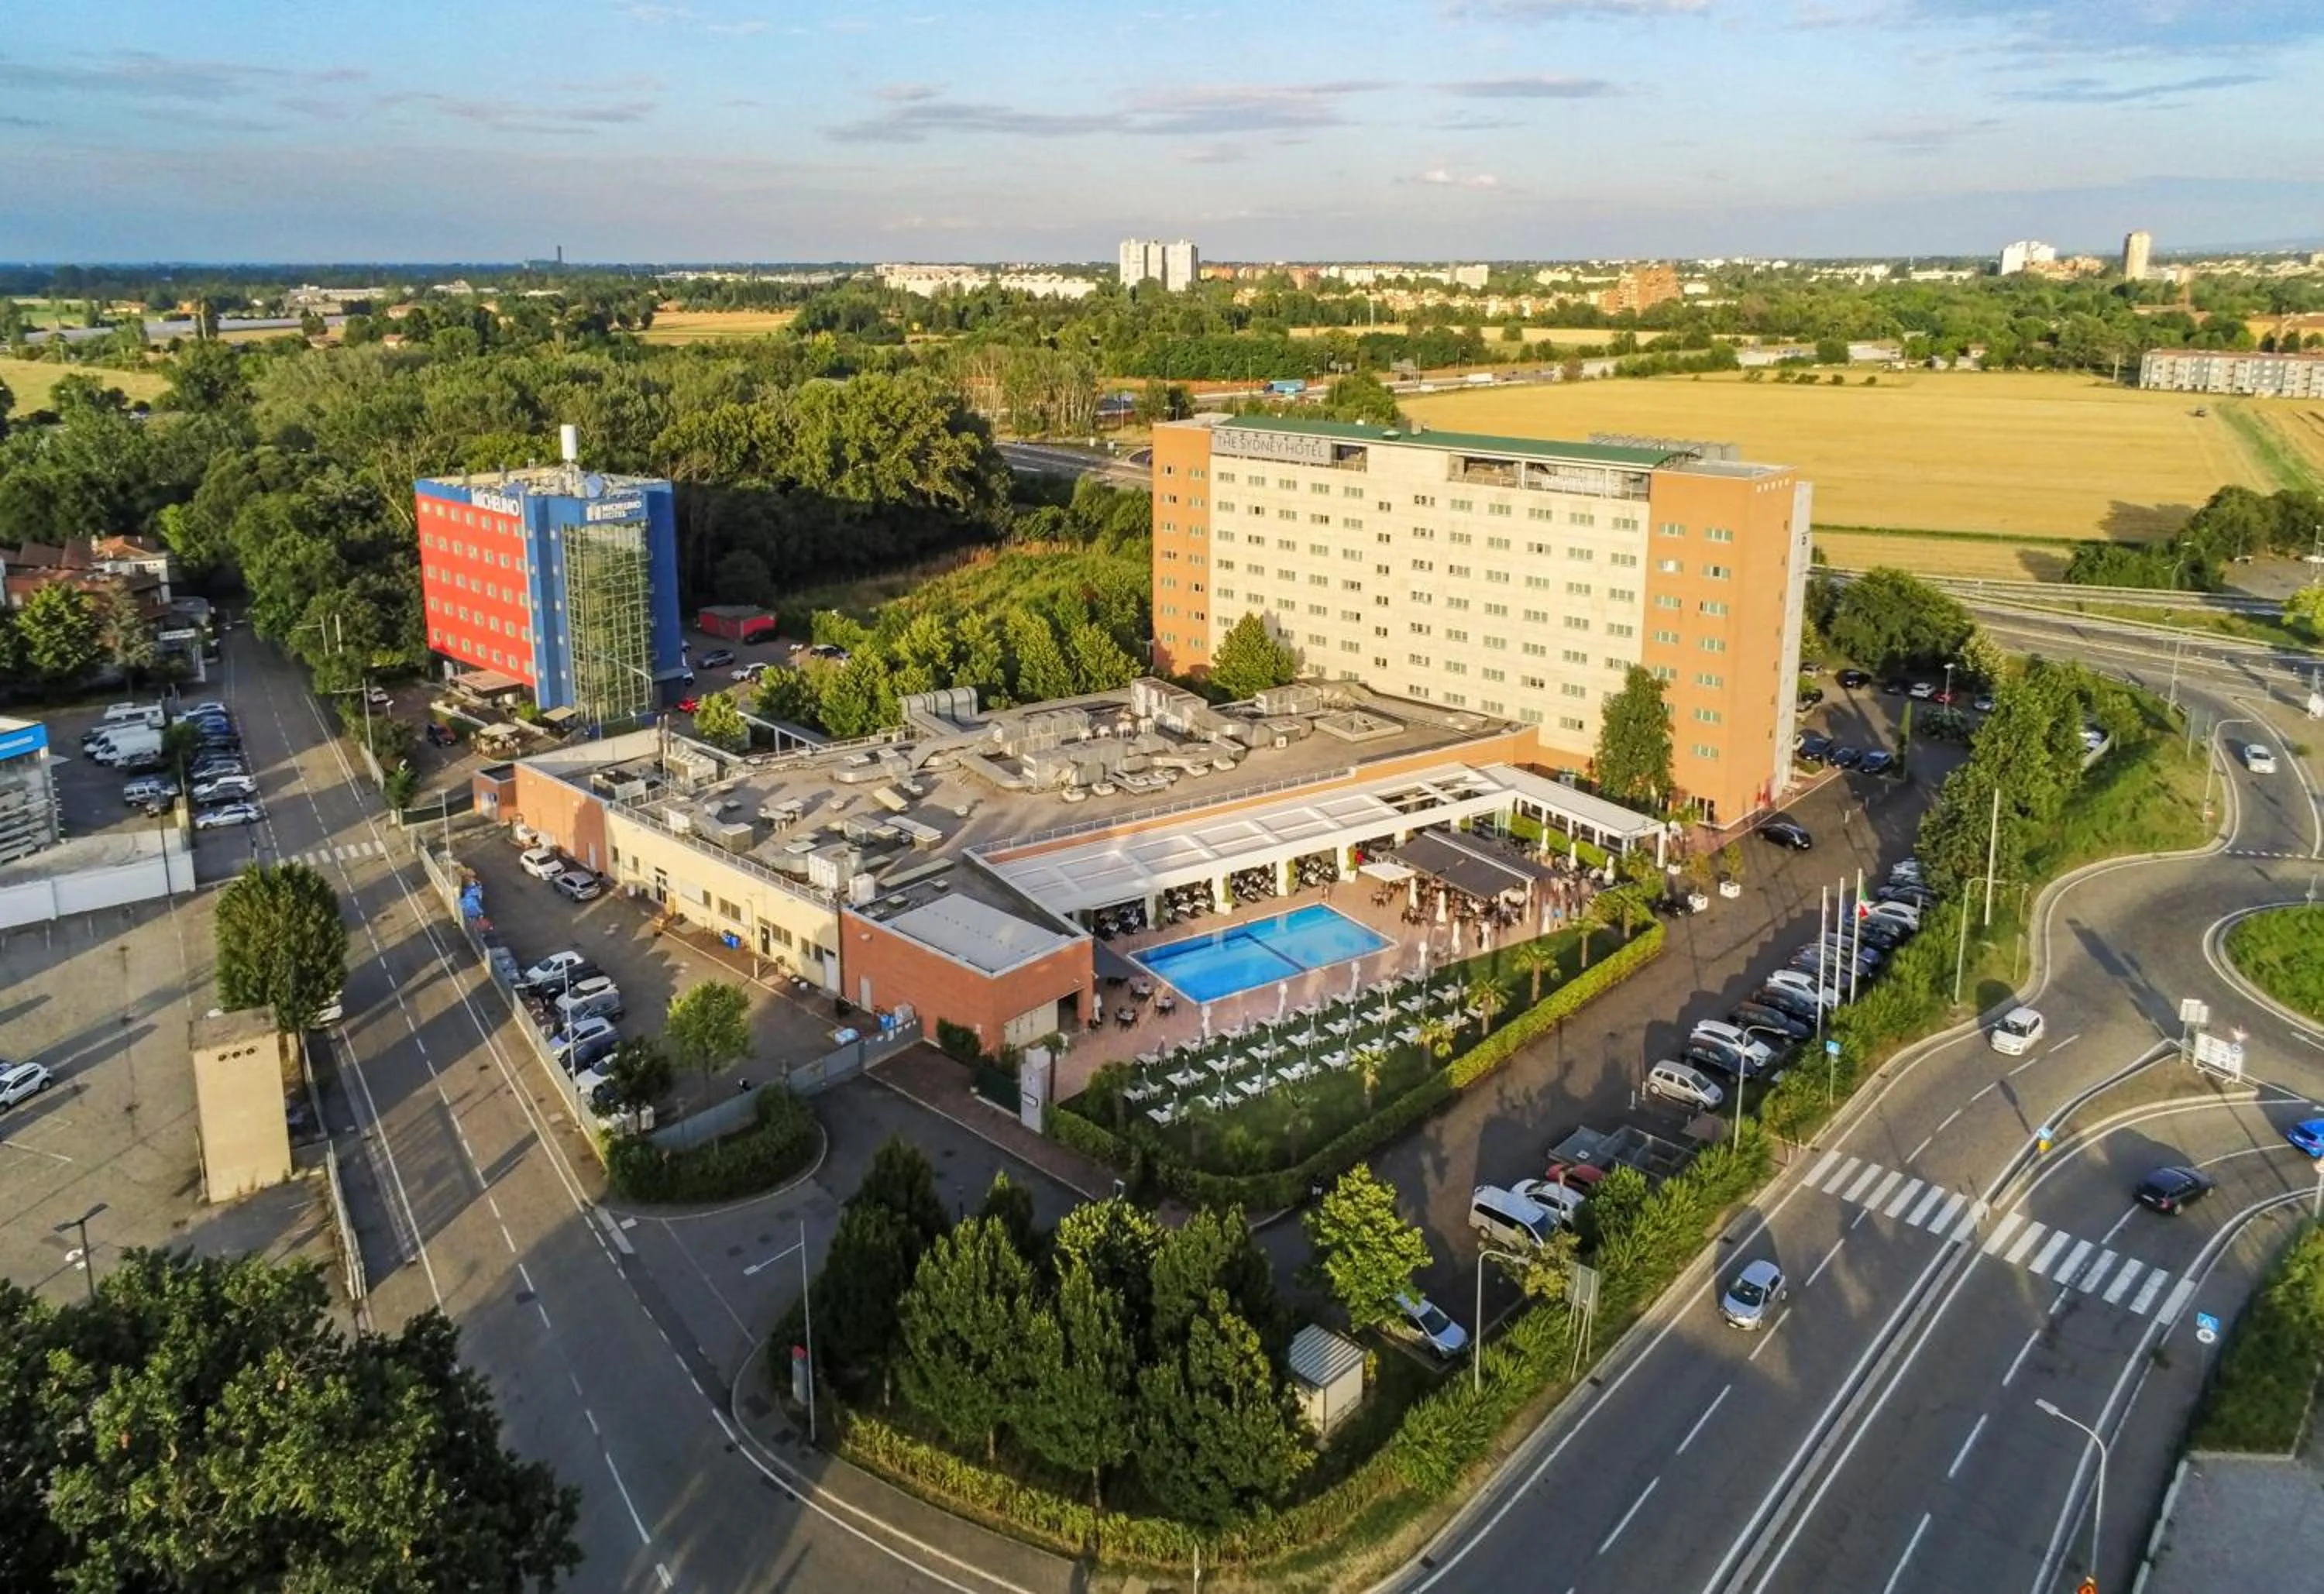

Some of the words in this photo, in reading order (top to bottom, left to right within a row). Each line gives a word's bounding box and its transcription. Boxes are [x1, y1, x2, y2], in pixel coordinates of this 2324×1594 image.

[1217, 435, 1237, 448] THE
[1240, 438, 1283, 454] SYDNEY
[1285, 443, 1325, 458] HOTEL
